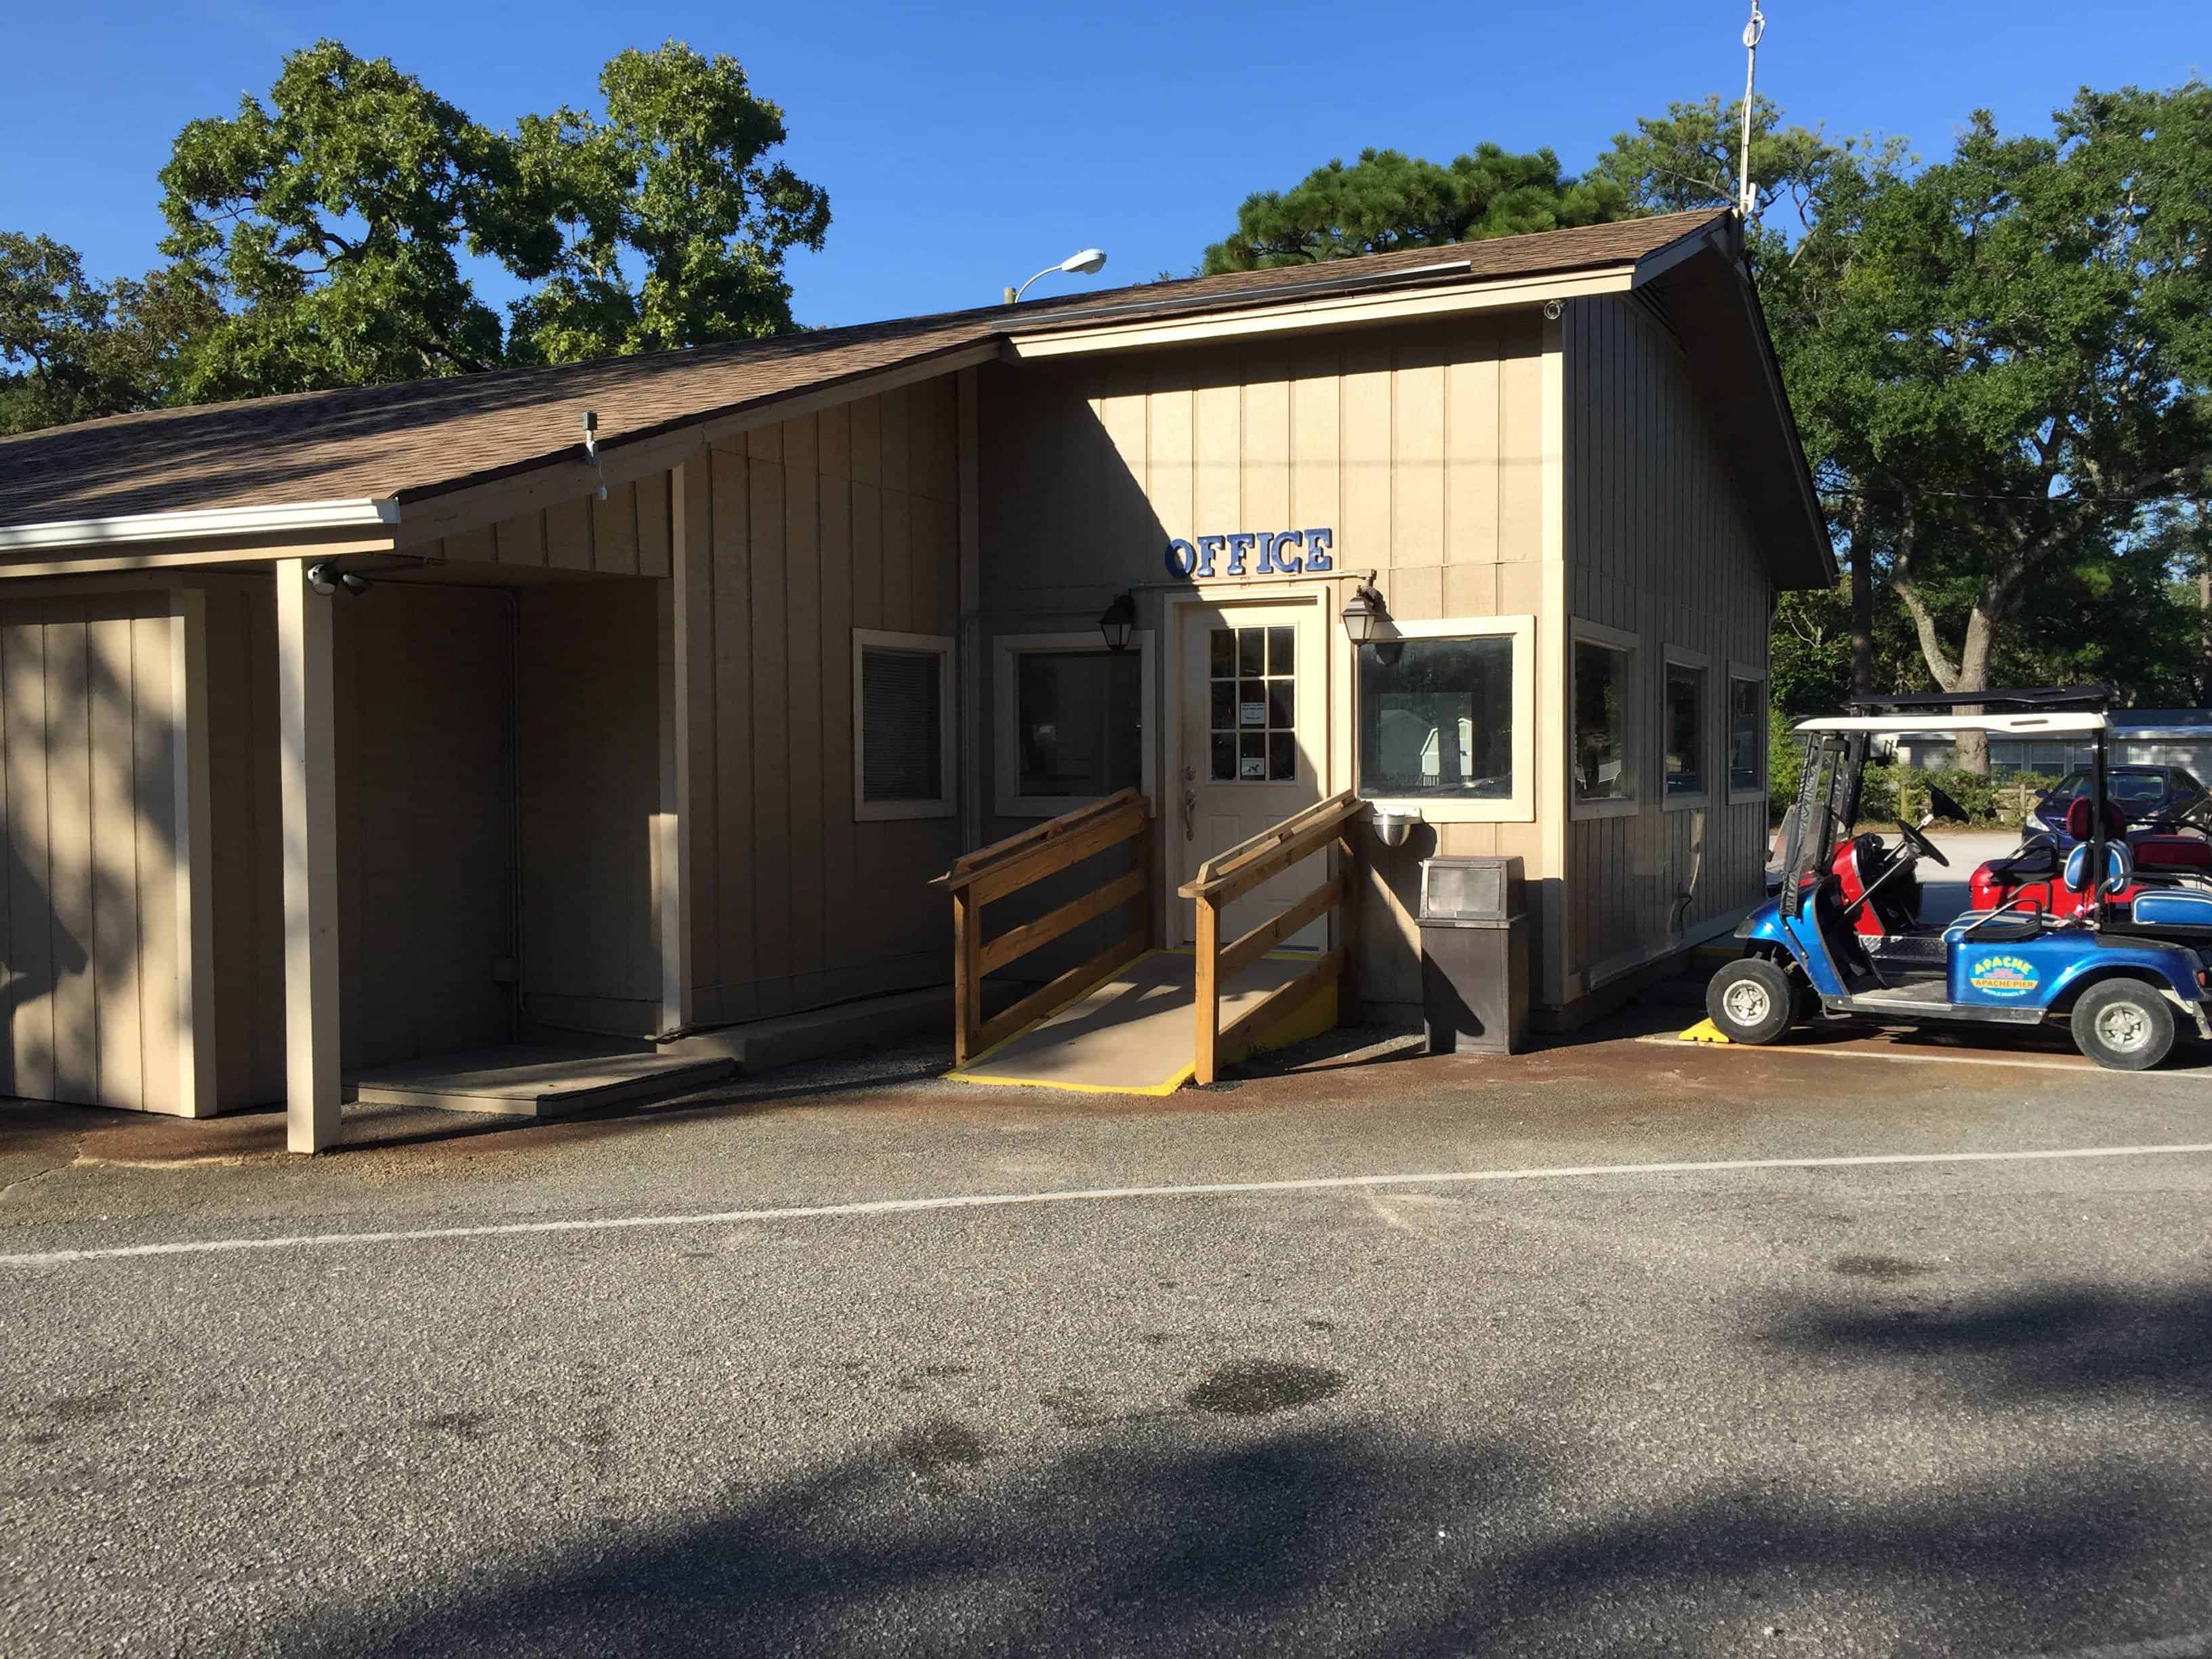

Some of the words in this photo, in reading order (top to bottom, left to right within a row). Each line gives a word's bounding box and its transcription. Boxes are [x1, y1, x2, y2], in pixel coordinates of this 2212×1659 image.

[1164, 528, 1333, 578] OFFICE
[1974, 955, 2033, 975] APACHE
[1975, 979, 2011, 987] APACHE
